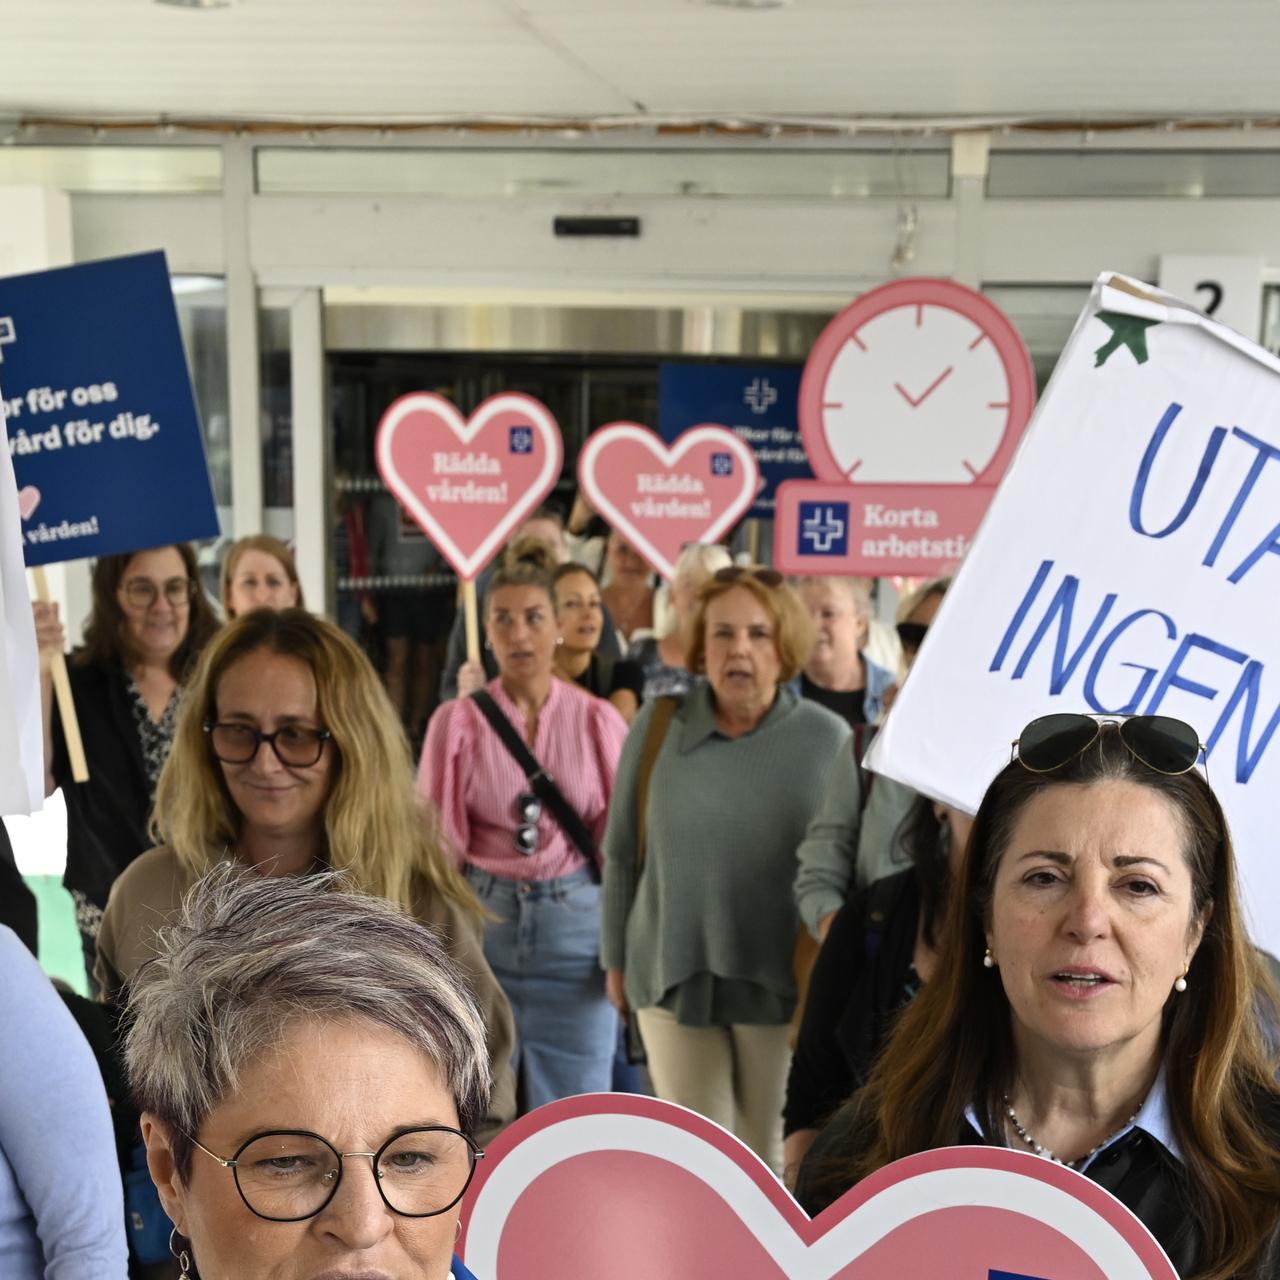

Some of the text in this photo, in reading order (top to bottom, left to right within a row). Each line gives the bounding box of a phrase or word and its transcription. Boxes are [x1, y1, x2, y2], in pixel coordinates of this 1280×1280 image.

[26, 385, 67, 414] för
[71, 381, 118, 407] oss
[63, 419, 105, 447] för
[108, 411, 160, 441] dig.
[433, 452, 502, 475] Rädda
[426, 479, 508, 503] vården!
[637, 473, 704, 494] Rädda
[630, 498, 711, 519] vården!
[863, 504, 939, 527] Korta
